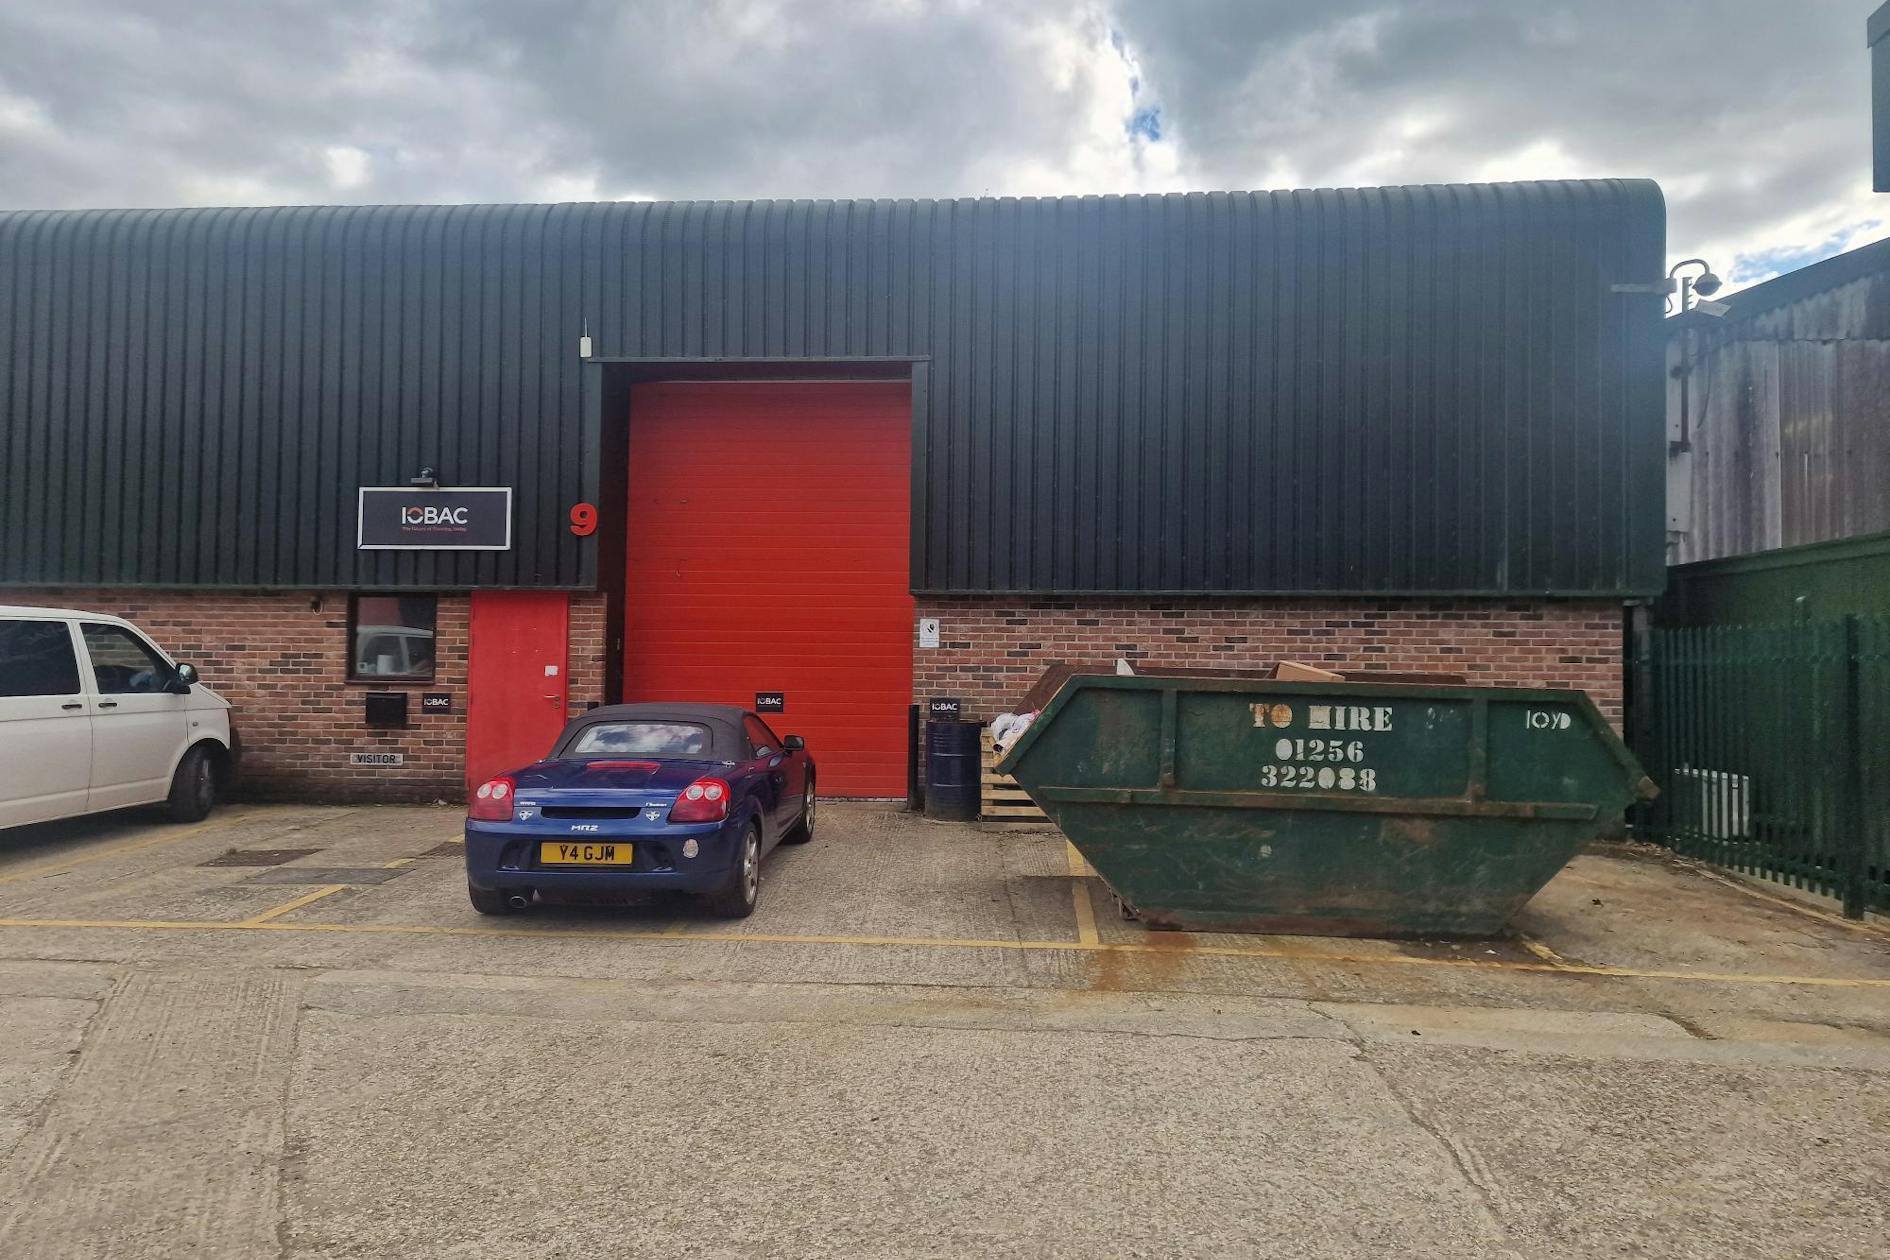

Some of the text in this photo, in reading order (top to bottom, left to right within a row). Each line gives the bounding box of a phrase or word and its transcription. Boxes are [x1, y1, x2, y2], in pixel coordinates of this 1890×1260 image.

[401, 506, 469, 525] IOBAC
[569, 502, 598, 536] 9
[423, 698, 449, 706] IOBAC
[757, 697, 782, 705] IOBAC
[931, 703, 958, 711] IOBAC
[1249, 703, 1393, 731] TO HIRE
[356, 753, 396, 764] VISITOR
[1275, 738, 1364, 762] 01256
[1261, 764, 1377, 792] 322088
[559, 845, 615, 861] Y4 GJM
